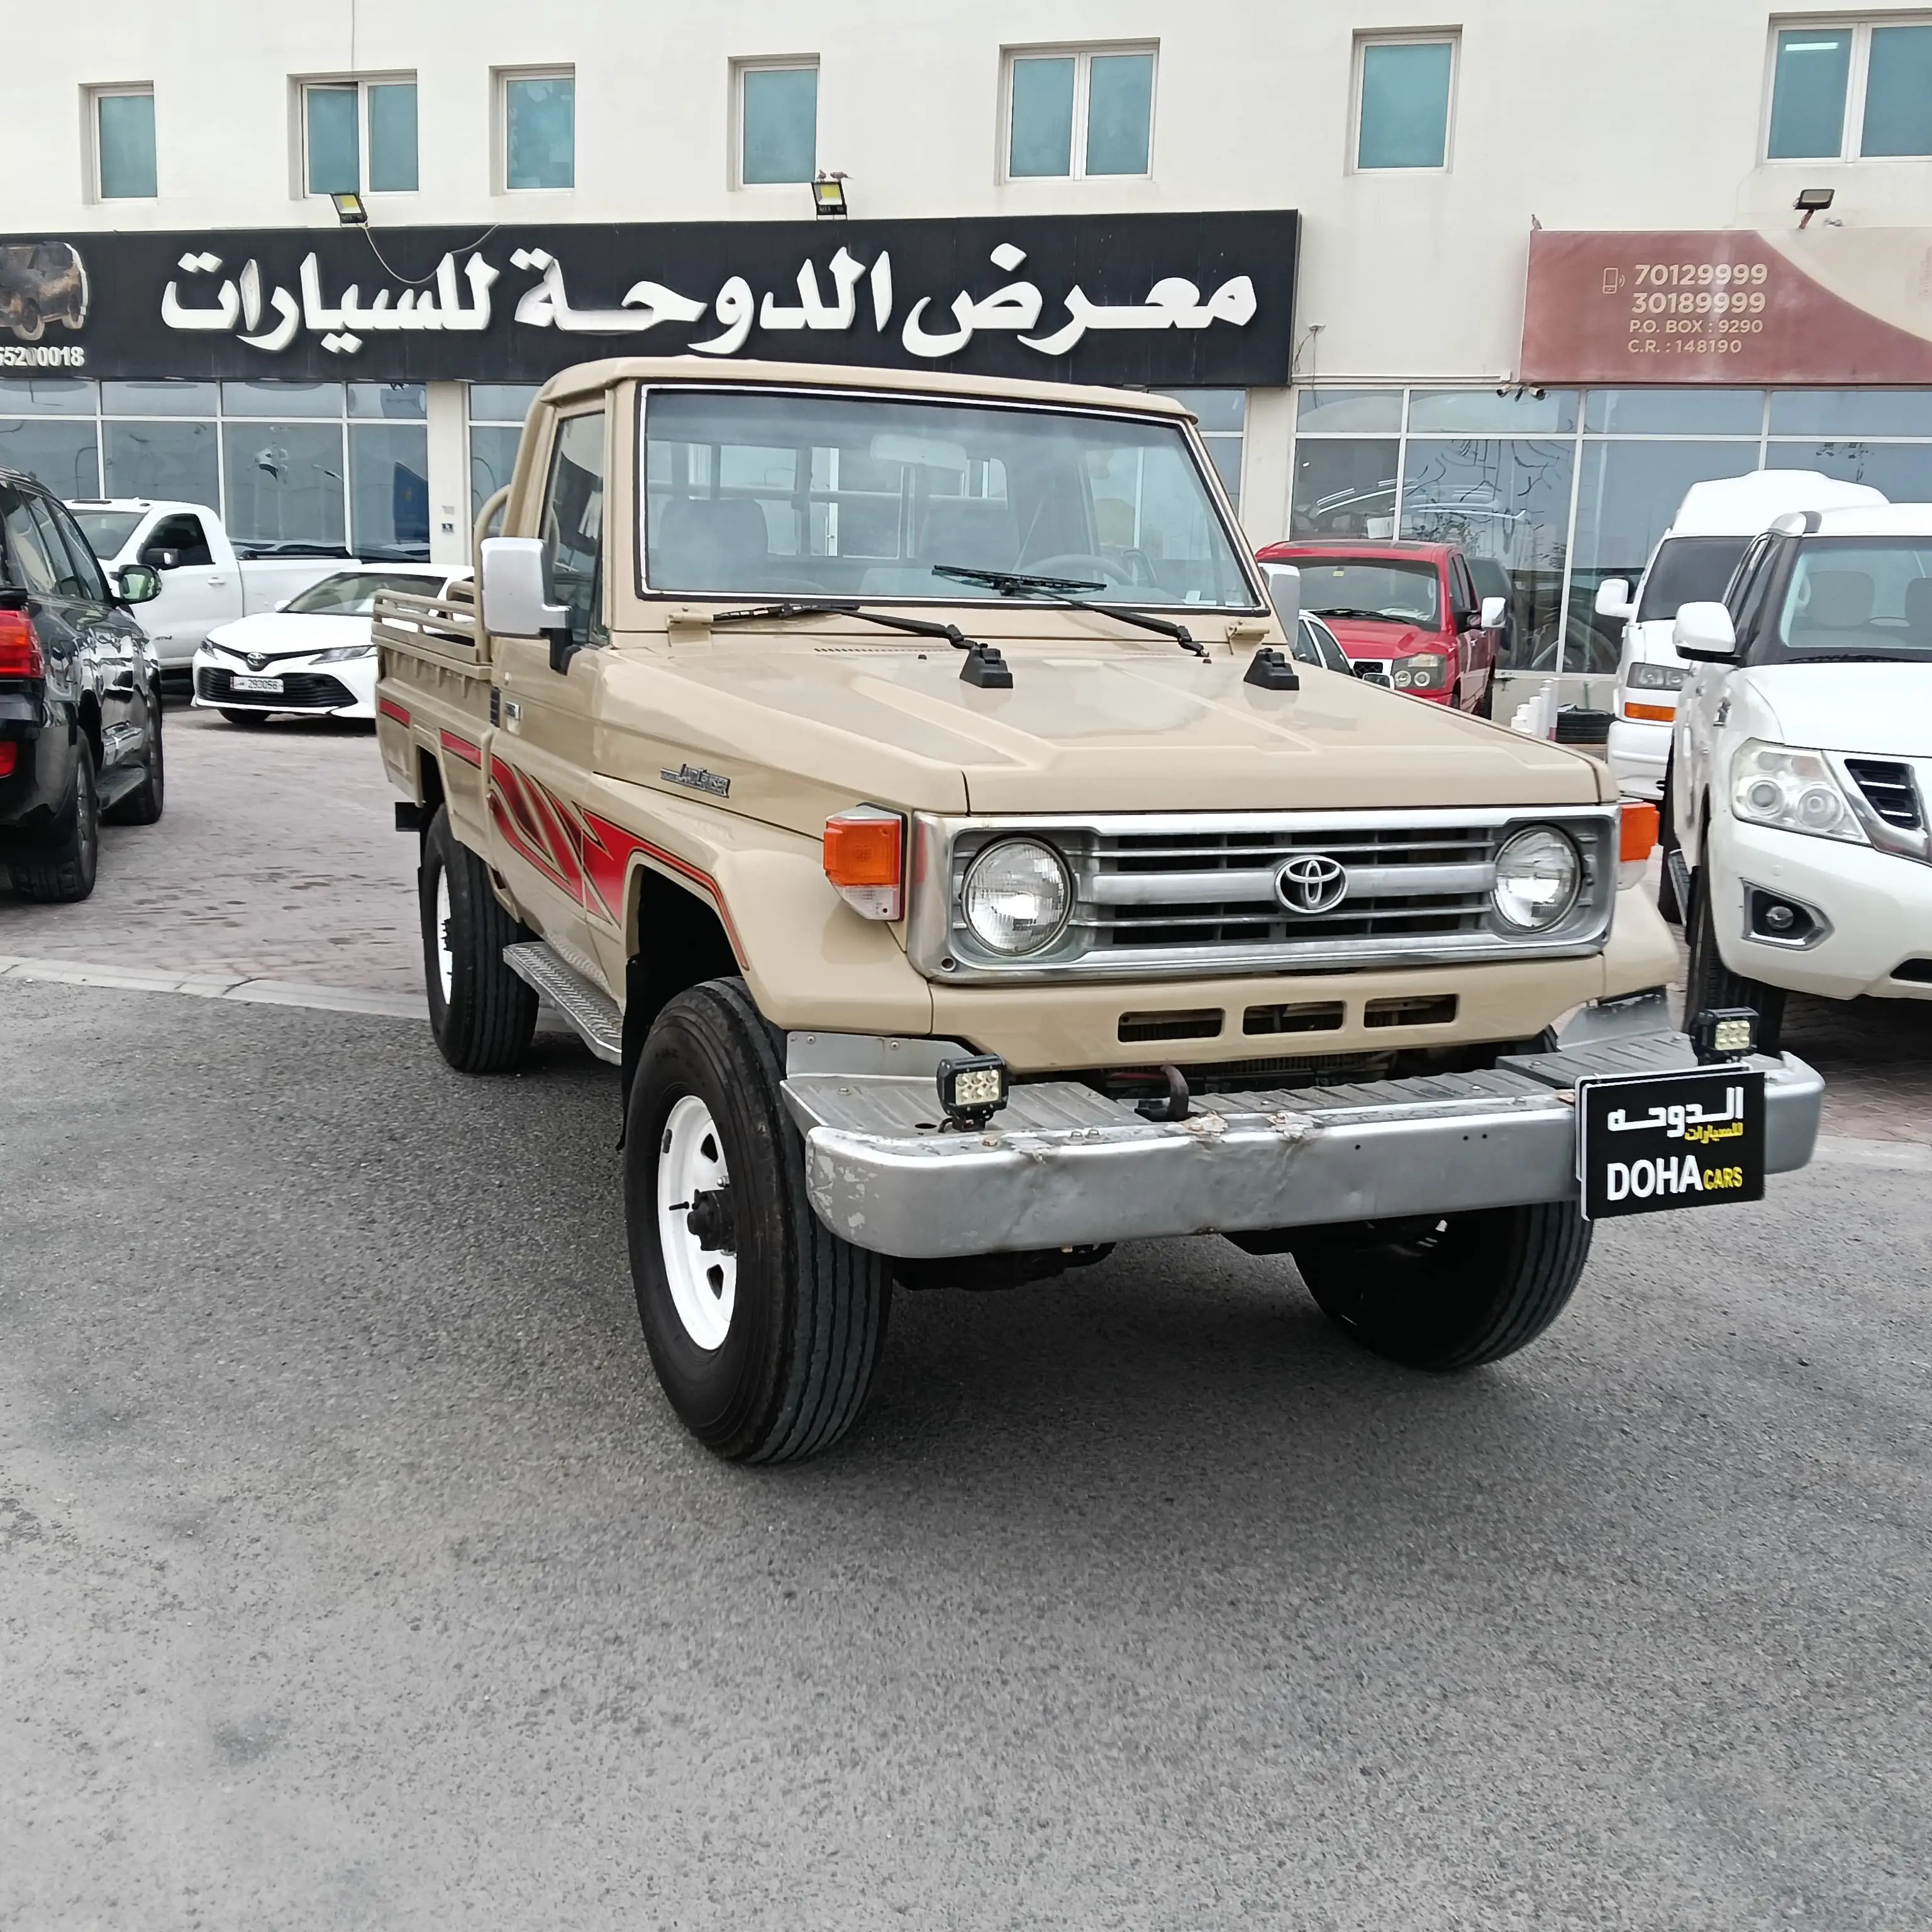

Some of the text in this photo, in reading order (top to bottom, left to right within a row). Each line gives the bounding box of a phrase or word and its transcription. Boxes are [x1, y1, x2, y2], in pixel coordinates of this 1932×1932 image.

[1635, 264, 1768, 286] 70129999
[161, 243, 1257, 357] معرض الدوحة للسيارات
[1631, 292, 1766, 314] 30189999
[1629, 319, 1661, 333] P.O.
[1665, 319, 1704, 333] BOX
[1718, 319, 1764, 334] 9290
[1628, 339, 1661, 353] C.R.
[1675, 339, 1743, 353] 148190
[1684, 1122, 1744, 1144] للسيارات
[1607, 1155, 1743, 1201] DOHA CARS
